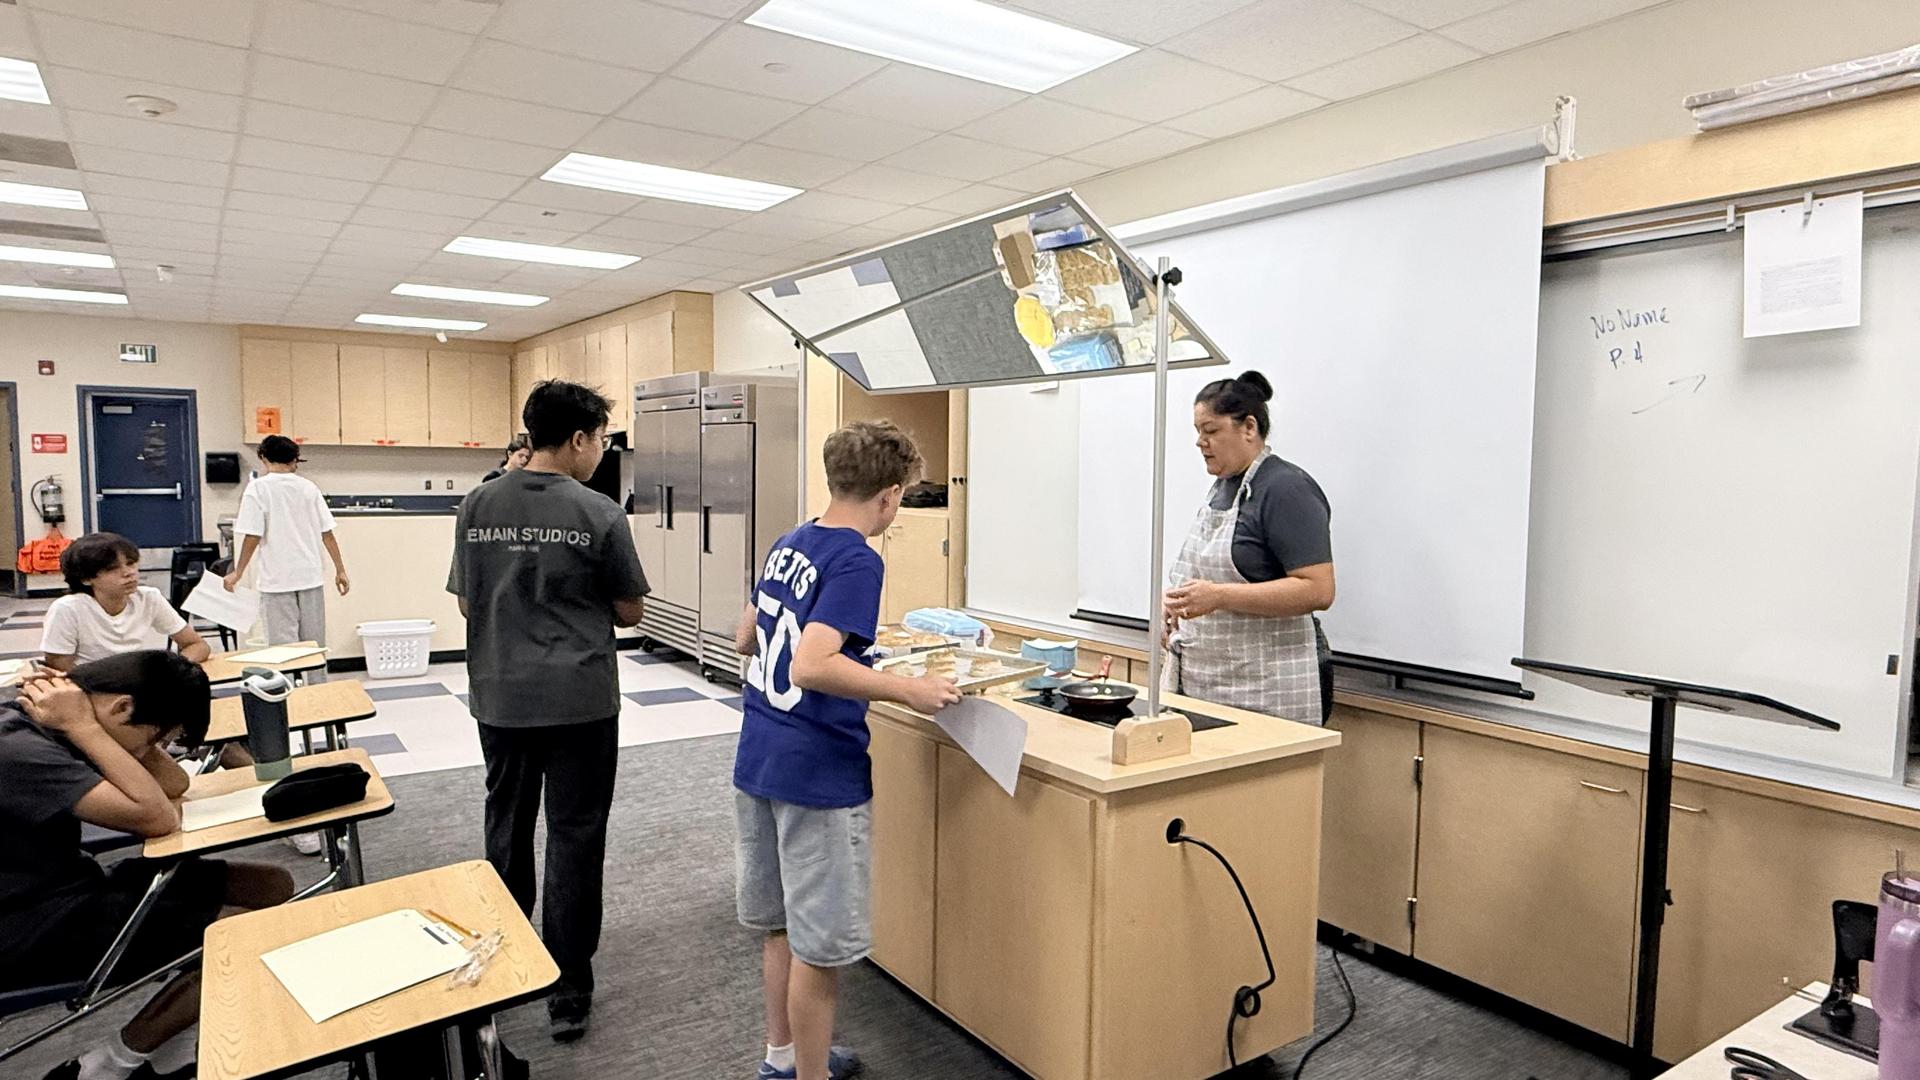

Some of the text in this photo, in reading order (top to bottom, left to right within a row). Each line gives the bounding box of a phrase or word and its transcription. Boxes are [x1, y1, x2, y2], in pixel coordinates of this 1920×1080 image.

[1590, 307, 1670, 339] No Name
[125, 344, 154, 362] EXIT
[1609, 340, 1643, 369] P. 4
[467, 527, 591, 547] EMAIN STUDIOS
[764, 547, 818, 600] BETTS
[747, 589, 804, 712] 50
